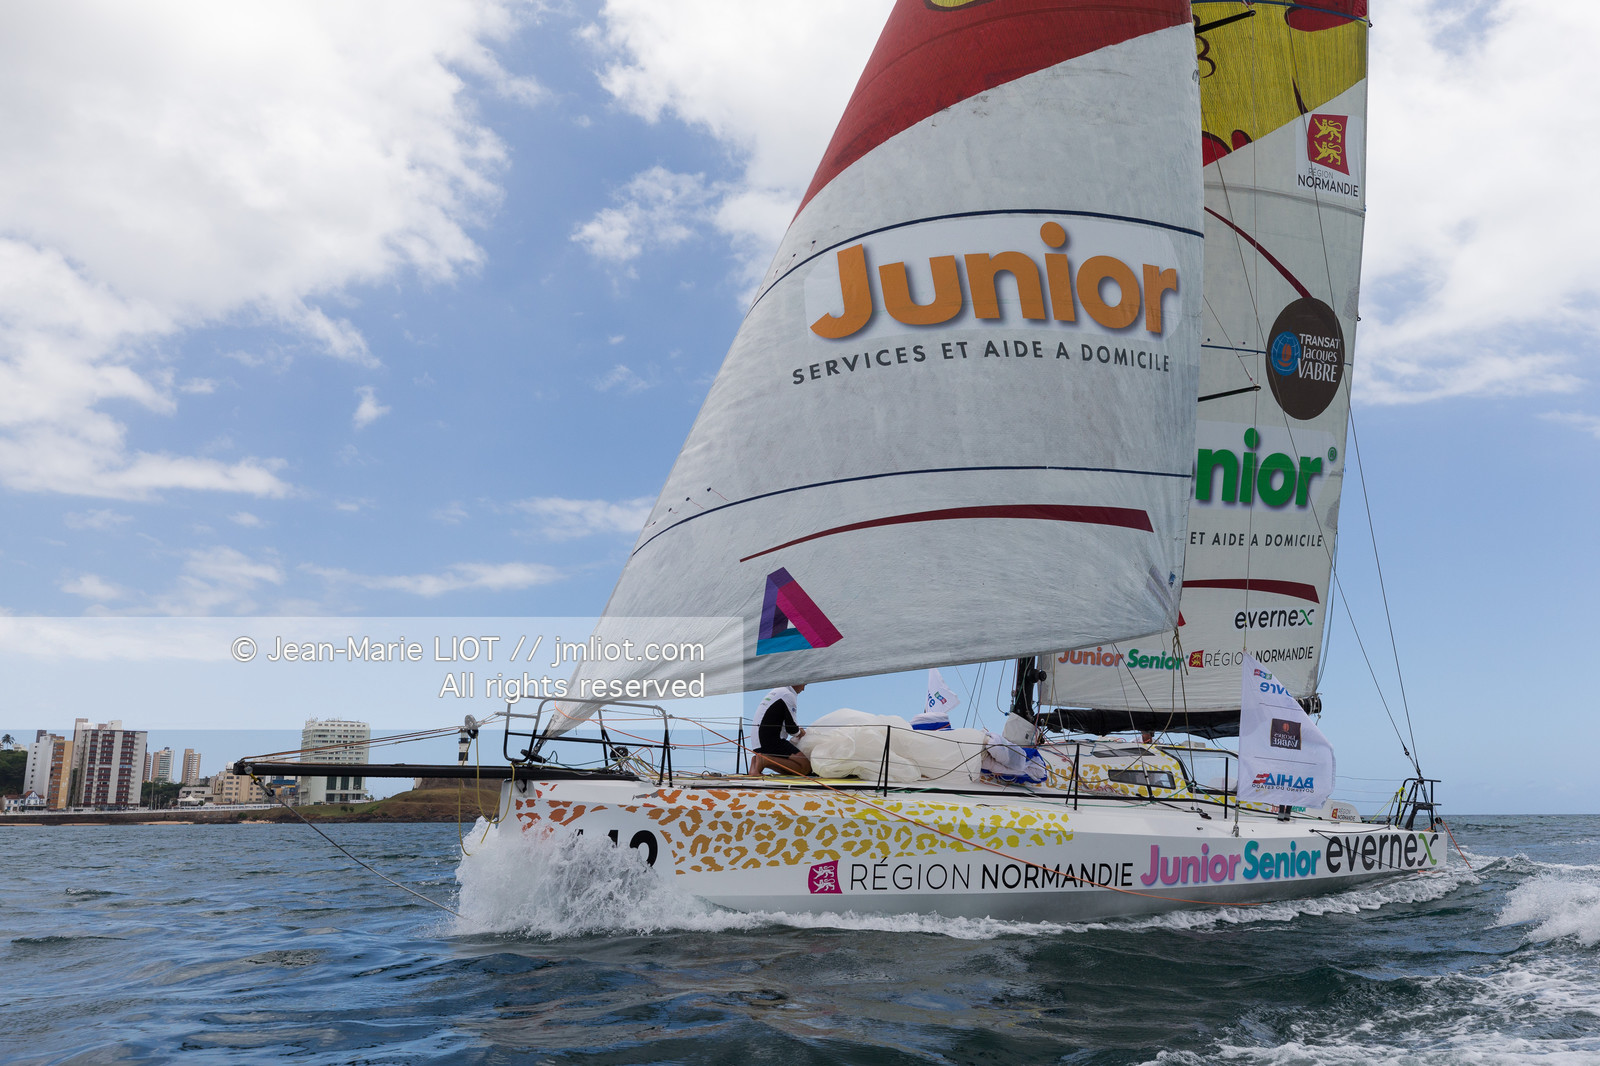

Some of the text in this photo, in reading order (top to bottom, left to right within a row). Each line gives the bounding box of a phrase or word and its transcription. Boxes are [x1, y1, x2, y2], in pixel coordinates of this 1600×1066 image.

[1297, 174, 1359, 198] NORMANDIE
[1308, 168, 1334, 180] RÉGION
[810, 221, 1177, 340] Junior
[1299, 333, 1341, 350] TRANSAT
[792, 339, 1170, 385] SERVICES ET AIDE A DOMICILE
[1301, 345, 1338, 364] Jacques
[1297, 357, 1338, 383] VABRE
[1190, 531, 1323, 548] ET AIDE A DOMICILE
[1234, 608, 1315, 630] evernex
[1058, 646, 1314, 670] Junior Senior RÉGIO NORMANDIE
[1140, 832, 1439, 886] Junior Senior evernex
[850, 857, 1134, 891] RÉGION NORMANDIE
